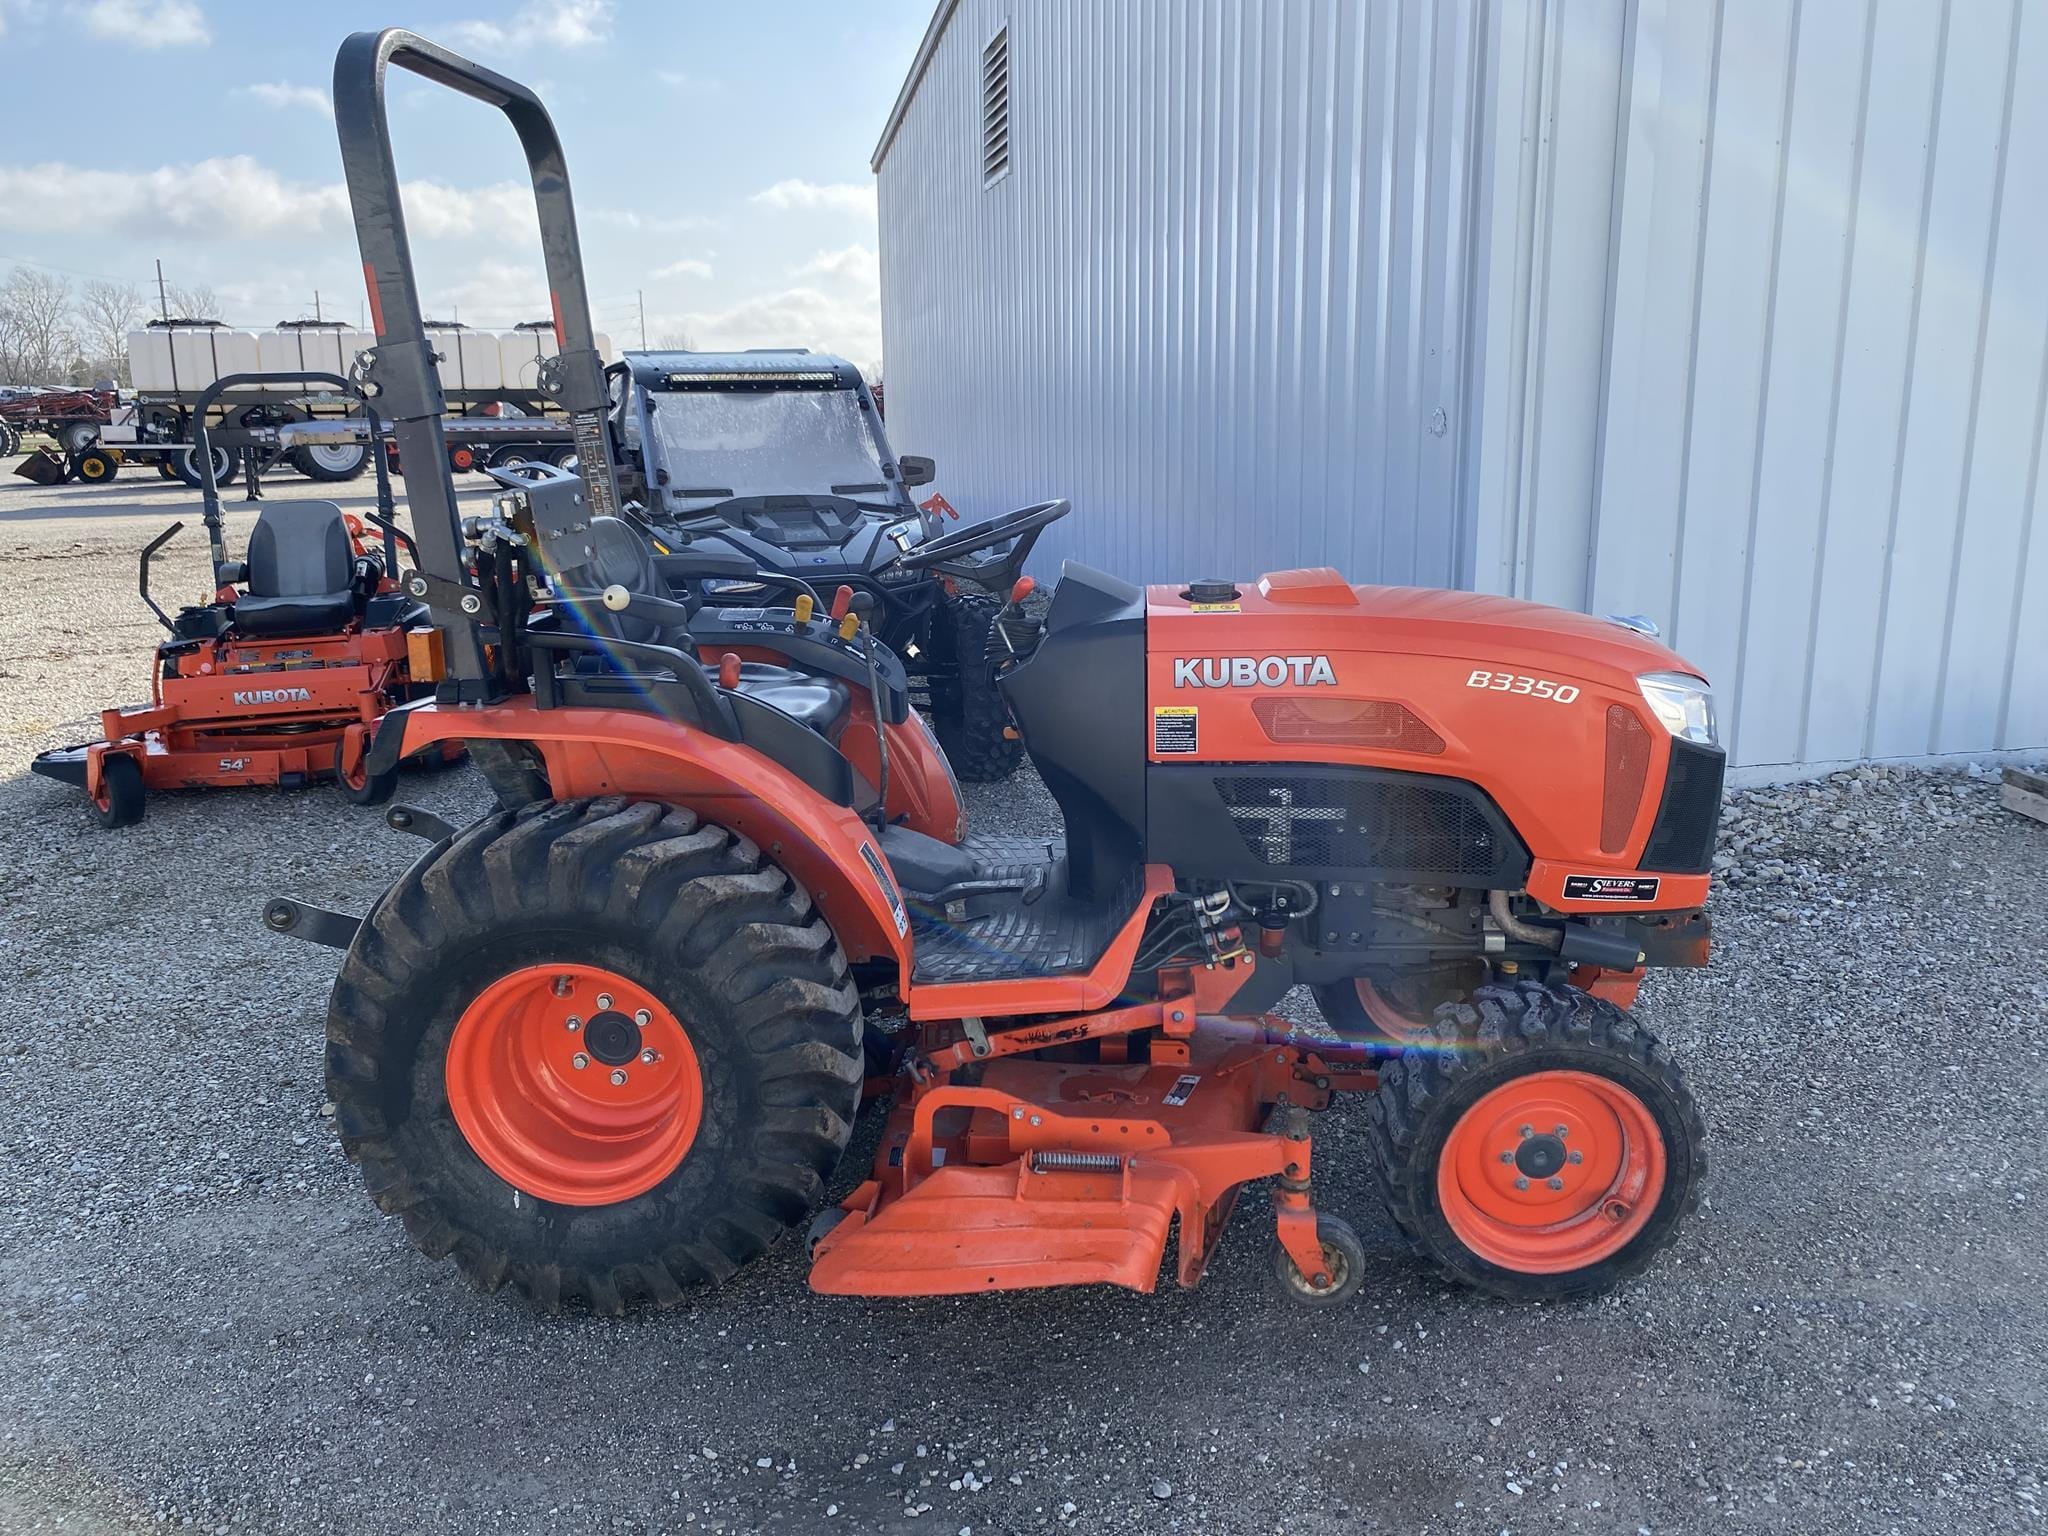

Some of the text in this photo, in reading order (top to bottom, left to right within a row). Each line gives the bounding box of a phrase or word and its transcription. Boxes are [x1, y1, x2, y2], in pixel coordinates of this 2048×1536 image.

[1174, 655, 1338, 688] KUBOTA
[233, 687, 312, 706] KUBOTA
[1465, 670, 1581, 704] B3350
[219, 757, 251, 772] 54"
[1589, 879, 1637, 893] SIEVERS
